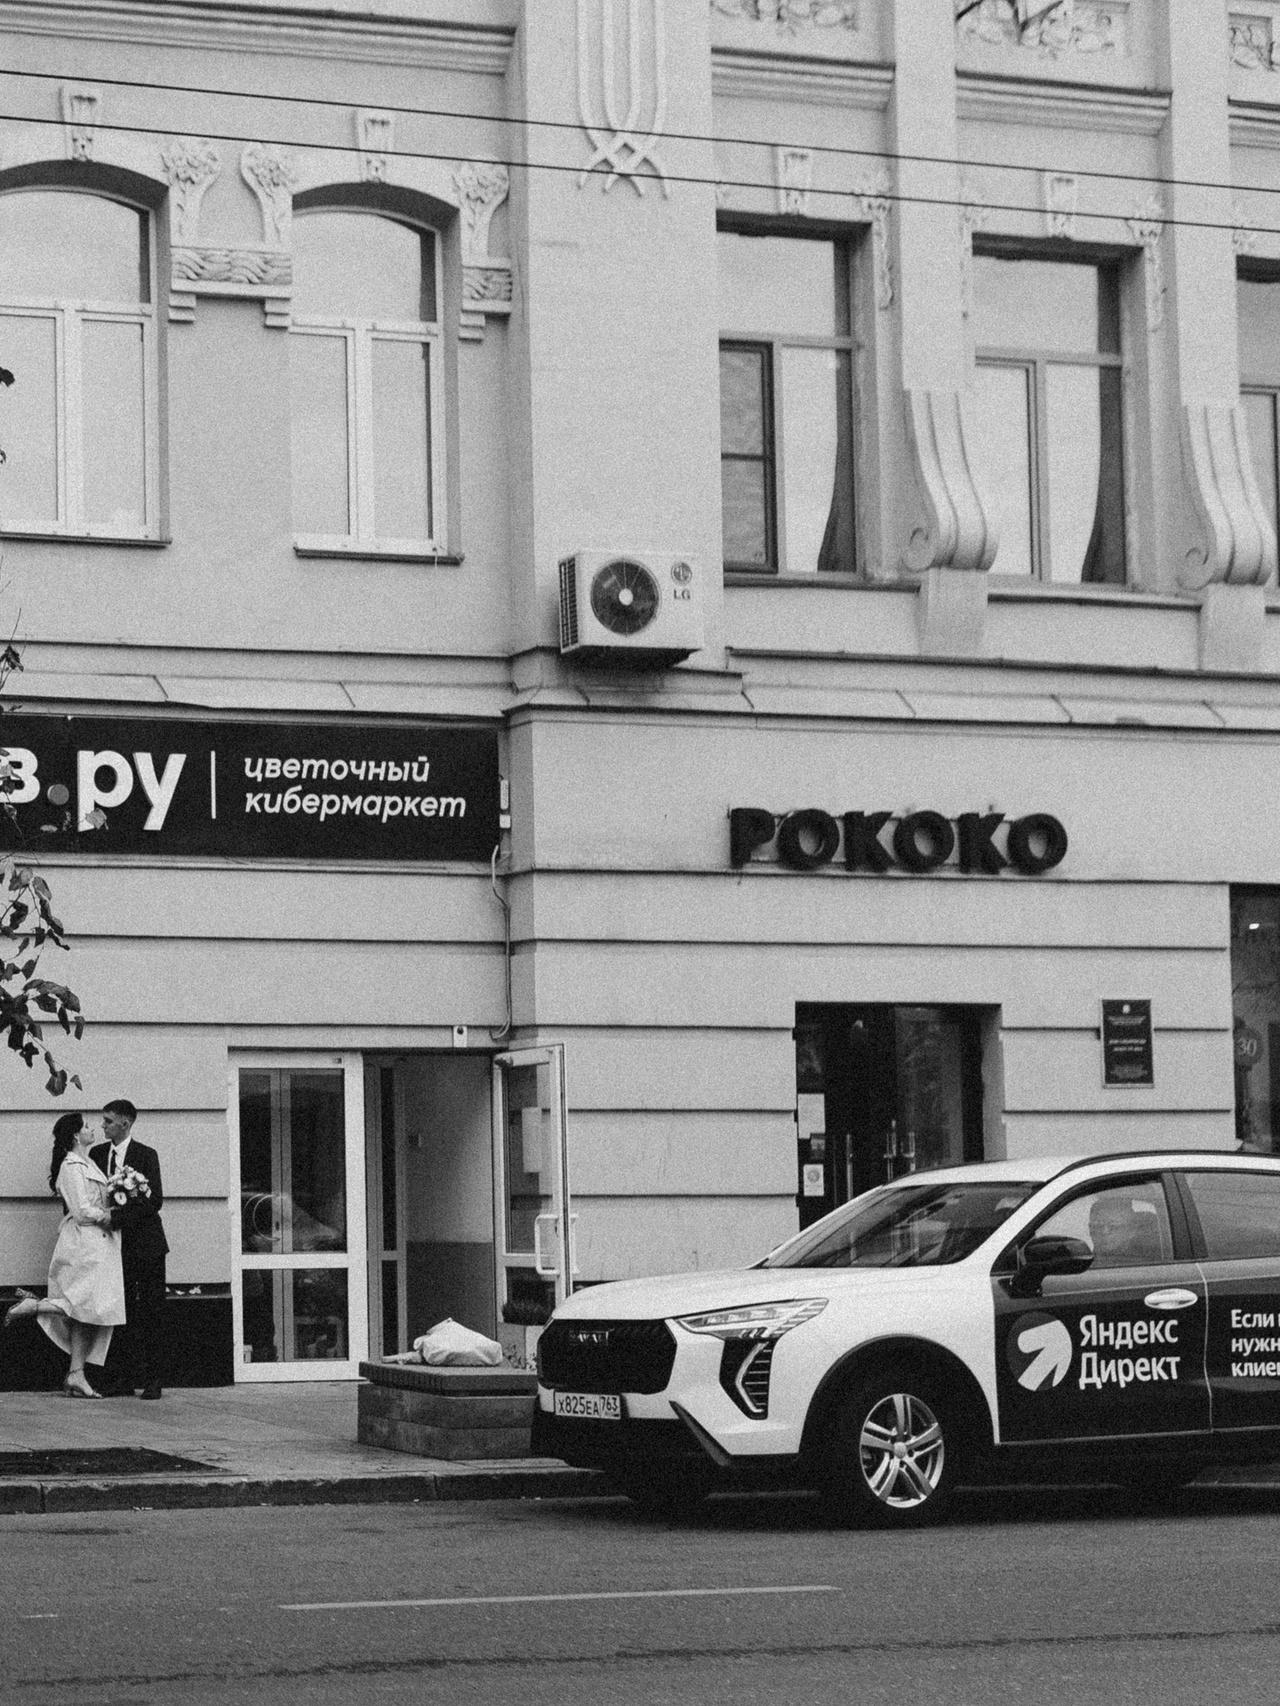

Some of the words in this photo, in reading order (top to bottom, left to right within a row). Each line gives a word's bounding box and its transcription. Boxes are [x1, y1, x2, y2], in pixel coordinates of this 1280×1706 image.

[243, 756, 430, 782] цветочный
[244, 785, 467, 823] кибермаркет
[729, 807, 1069, 876] РОКОКО
[1079, 1314, 1179, 1349] Яндекс
[1231, 1308, 1275, 1328] Если
[1078, 1352, 1181, 1390] Директ
[1231, 1361, 1280, 1377] клие
